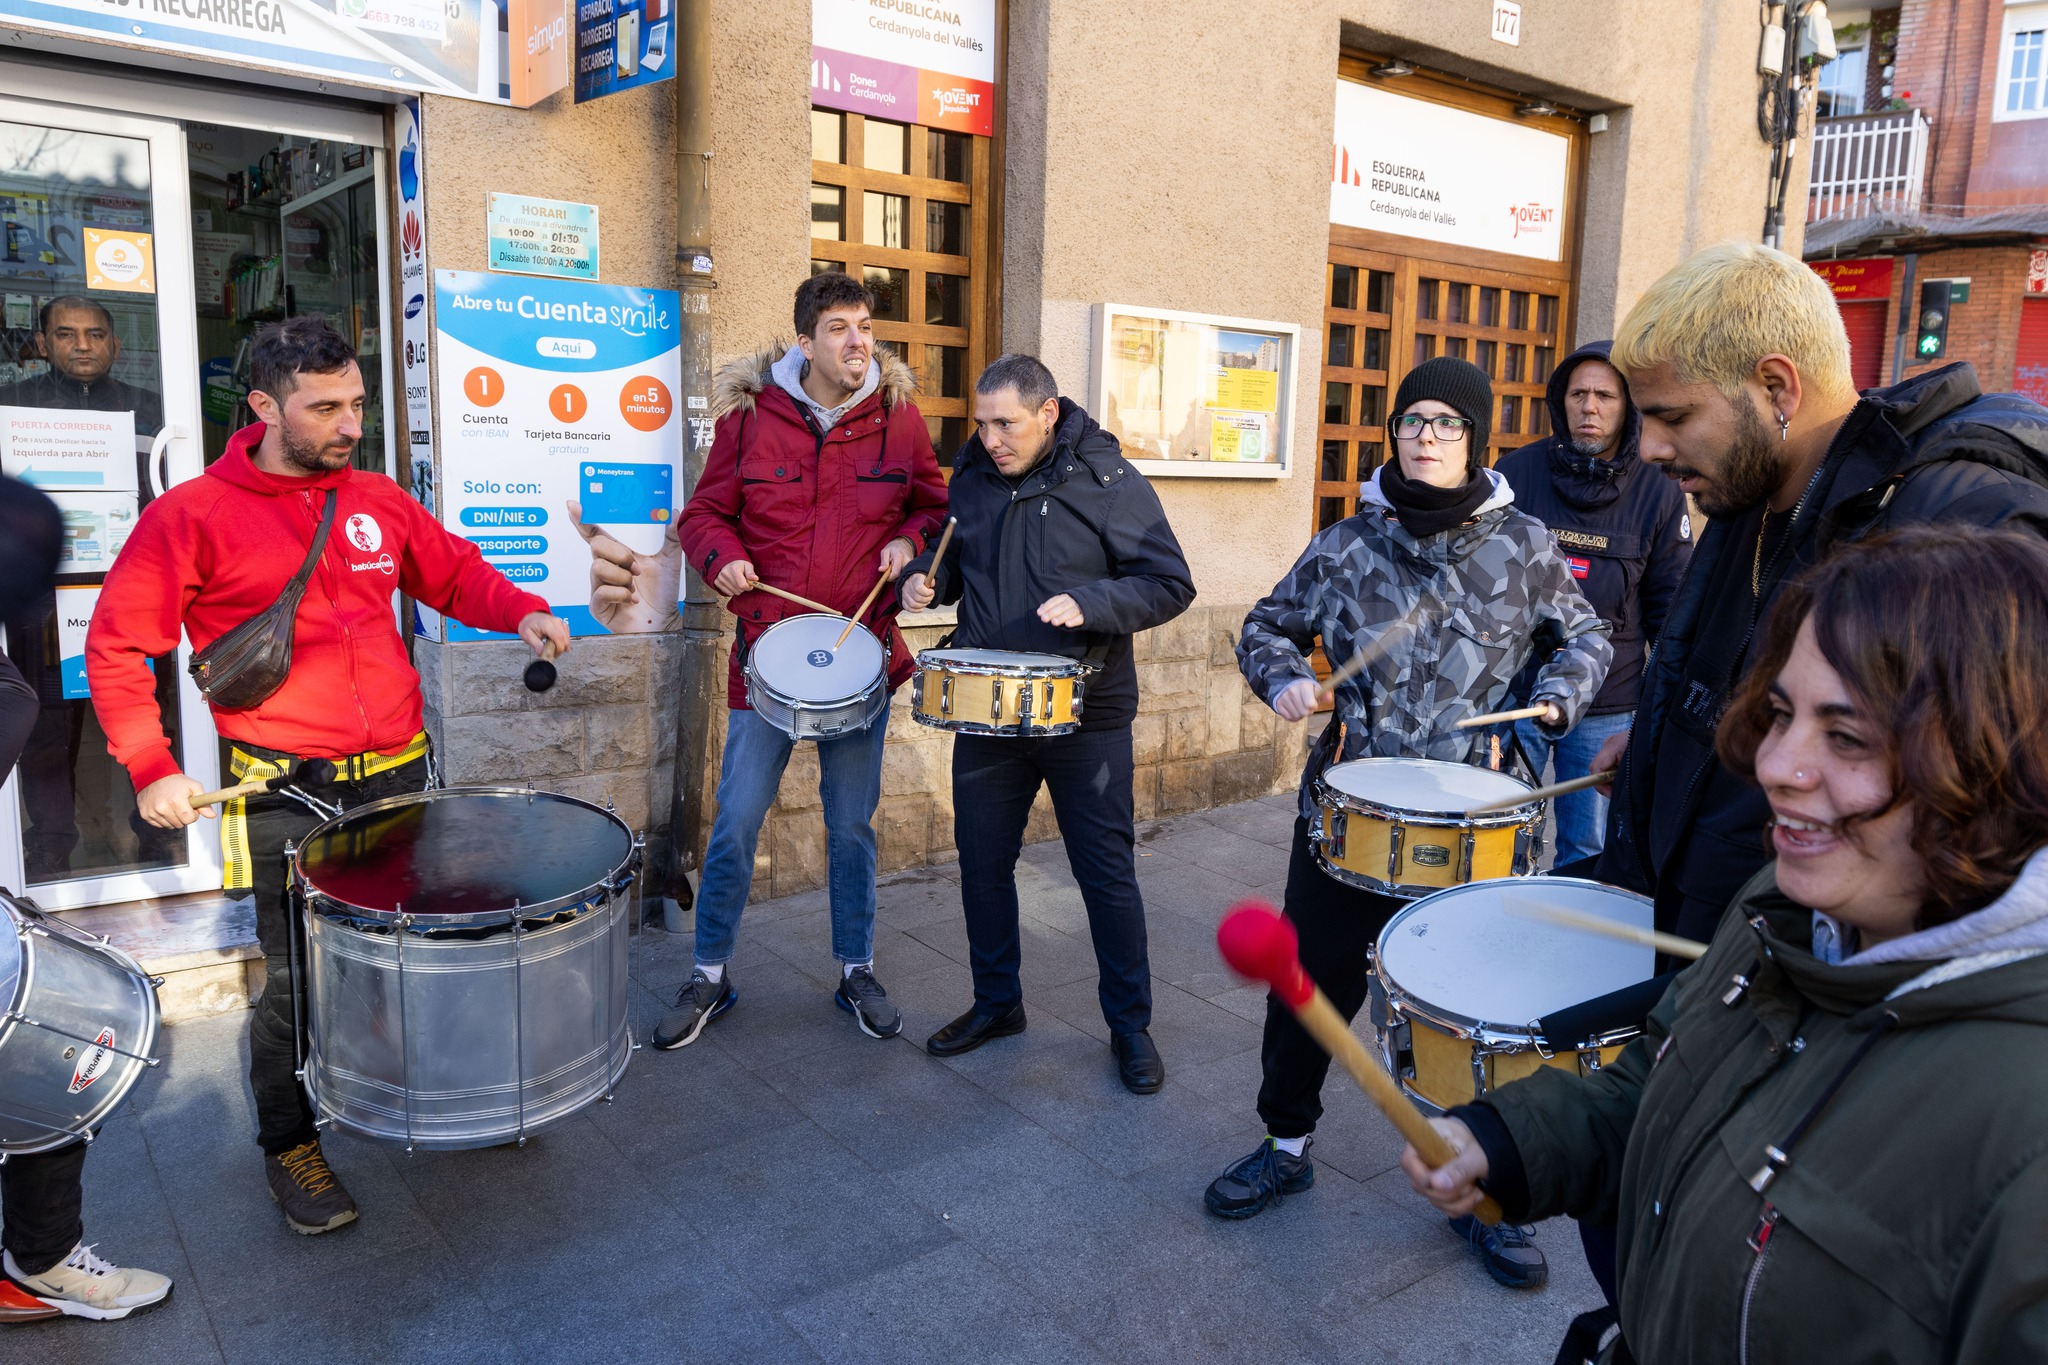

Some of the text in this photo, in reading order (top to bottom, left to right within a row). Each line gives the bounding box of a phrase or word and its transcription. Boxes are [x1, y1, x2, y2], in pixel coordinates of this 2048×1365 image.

[368, 10, 440, 32] 663 798 452
[1496, 8, 1517, 35] 177
[528, 16, 564, 55] simyo
[580, 24, 612, 49] TARRGETES
[869, 16, 983, 52] Cerdanyola del Vallès
[580, 49, 614, 73] RECARREGA
[850, 73, 877, 88] Dones
[850, 86, 896, 105] Cerdanyola
[1372, 160, 1426, 182] ESQUERRA
[1371, 178, 1441, 203] REPUBLICANA
[522, 204, 567, 220] HORARI
[1370, 200, 1457, 227] Cerdanyola del Vallès
[499, 215, 511, 223] De
[513, 216, 540, 227] dilluns
[550, 221, 588, 233] divendres
[508, 228, 535, 238] 10:00
[552, 232, 579, 244] 01:30
[509, 240, 540, 251] 17:00h
[550, 244, 576, 255] 20:30
[101, 261, 139, 270] MoneyGram
[499, 251, 530, 264] Dissabte
[532, 255, 557, 266] 10:00h
[404, 263, 424, 280] HUAWEI
[452, 294, 493, 311] Abre
[496, 298, 513, 313] tu
[517, 295, 607, 324] Cuenta
[610, 293, 670, 330] smile
[415, 342, 426, 364] LG
[552, 341, 582, 354] Aquí
[407, 386, 427, 399] SONY
[479, 375, 489, 396] 1
[563, 392, 573, 413] 1
[632, 387, 658, 403] en 5
[626, 402, 666, 414] minutos
[11, 421, 113, 432] PUERTA CORREDERA
[462, 413, 508, 425] Cuenta
[461, 428, 510, 438] con IBAN
[524, 429, 611, 442] Tarjeta Bancaria
[13, 449, 110, 459] Izquierda para Abrir
[549, 444, 589, 456] gratuita
[597, 468, 634, 476] Moneytrans
[463, 480, 542, 495] Solo con:
[474, 508, 537, 525] DNI/NIE o
[476, 538, 541, 553] asaporte
[498, 565, 543, 577] ección
